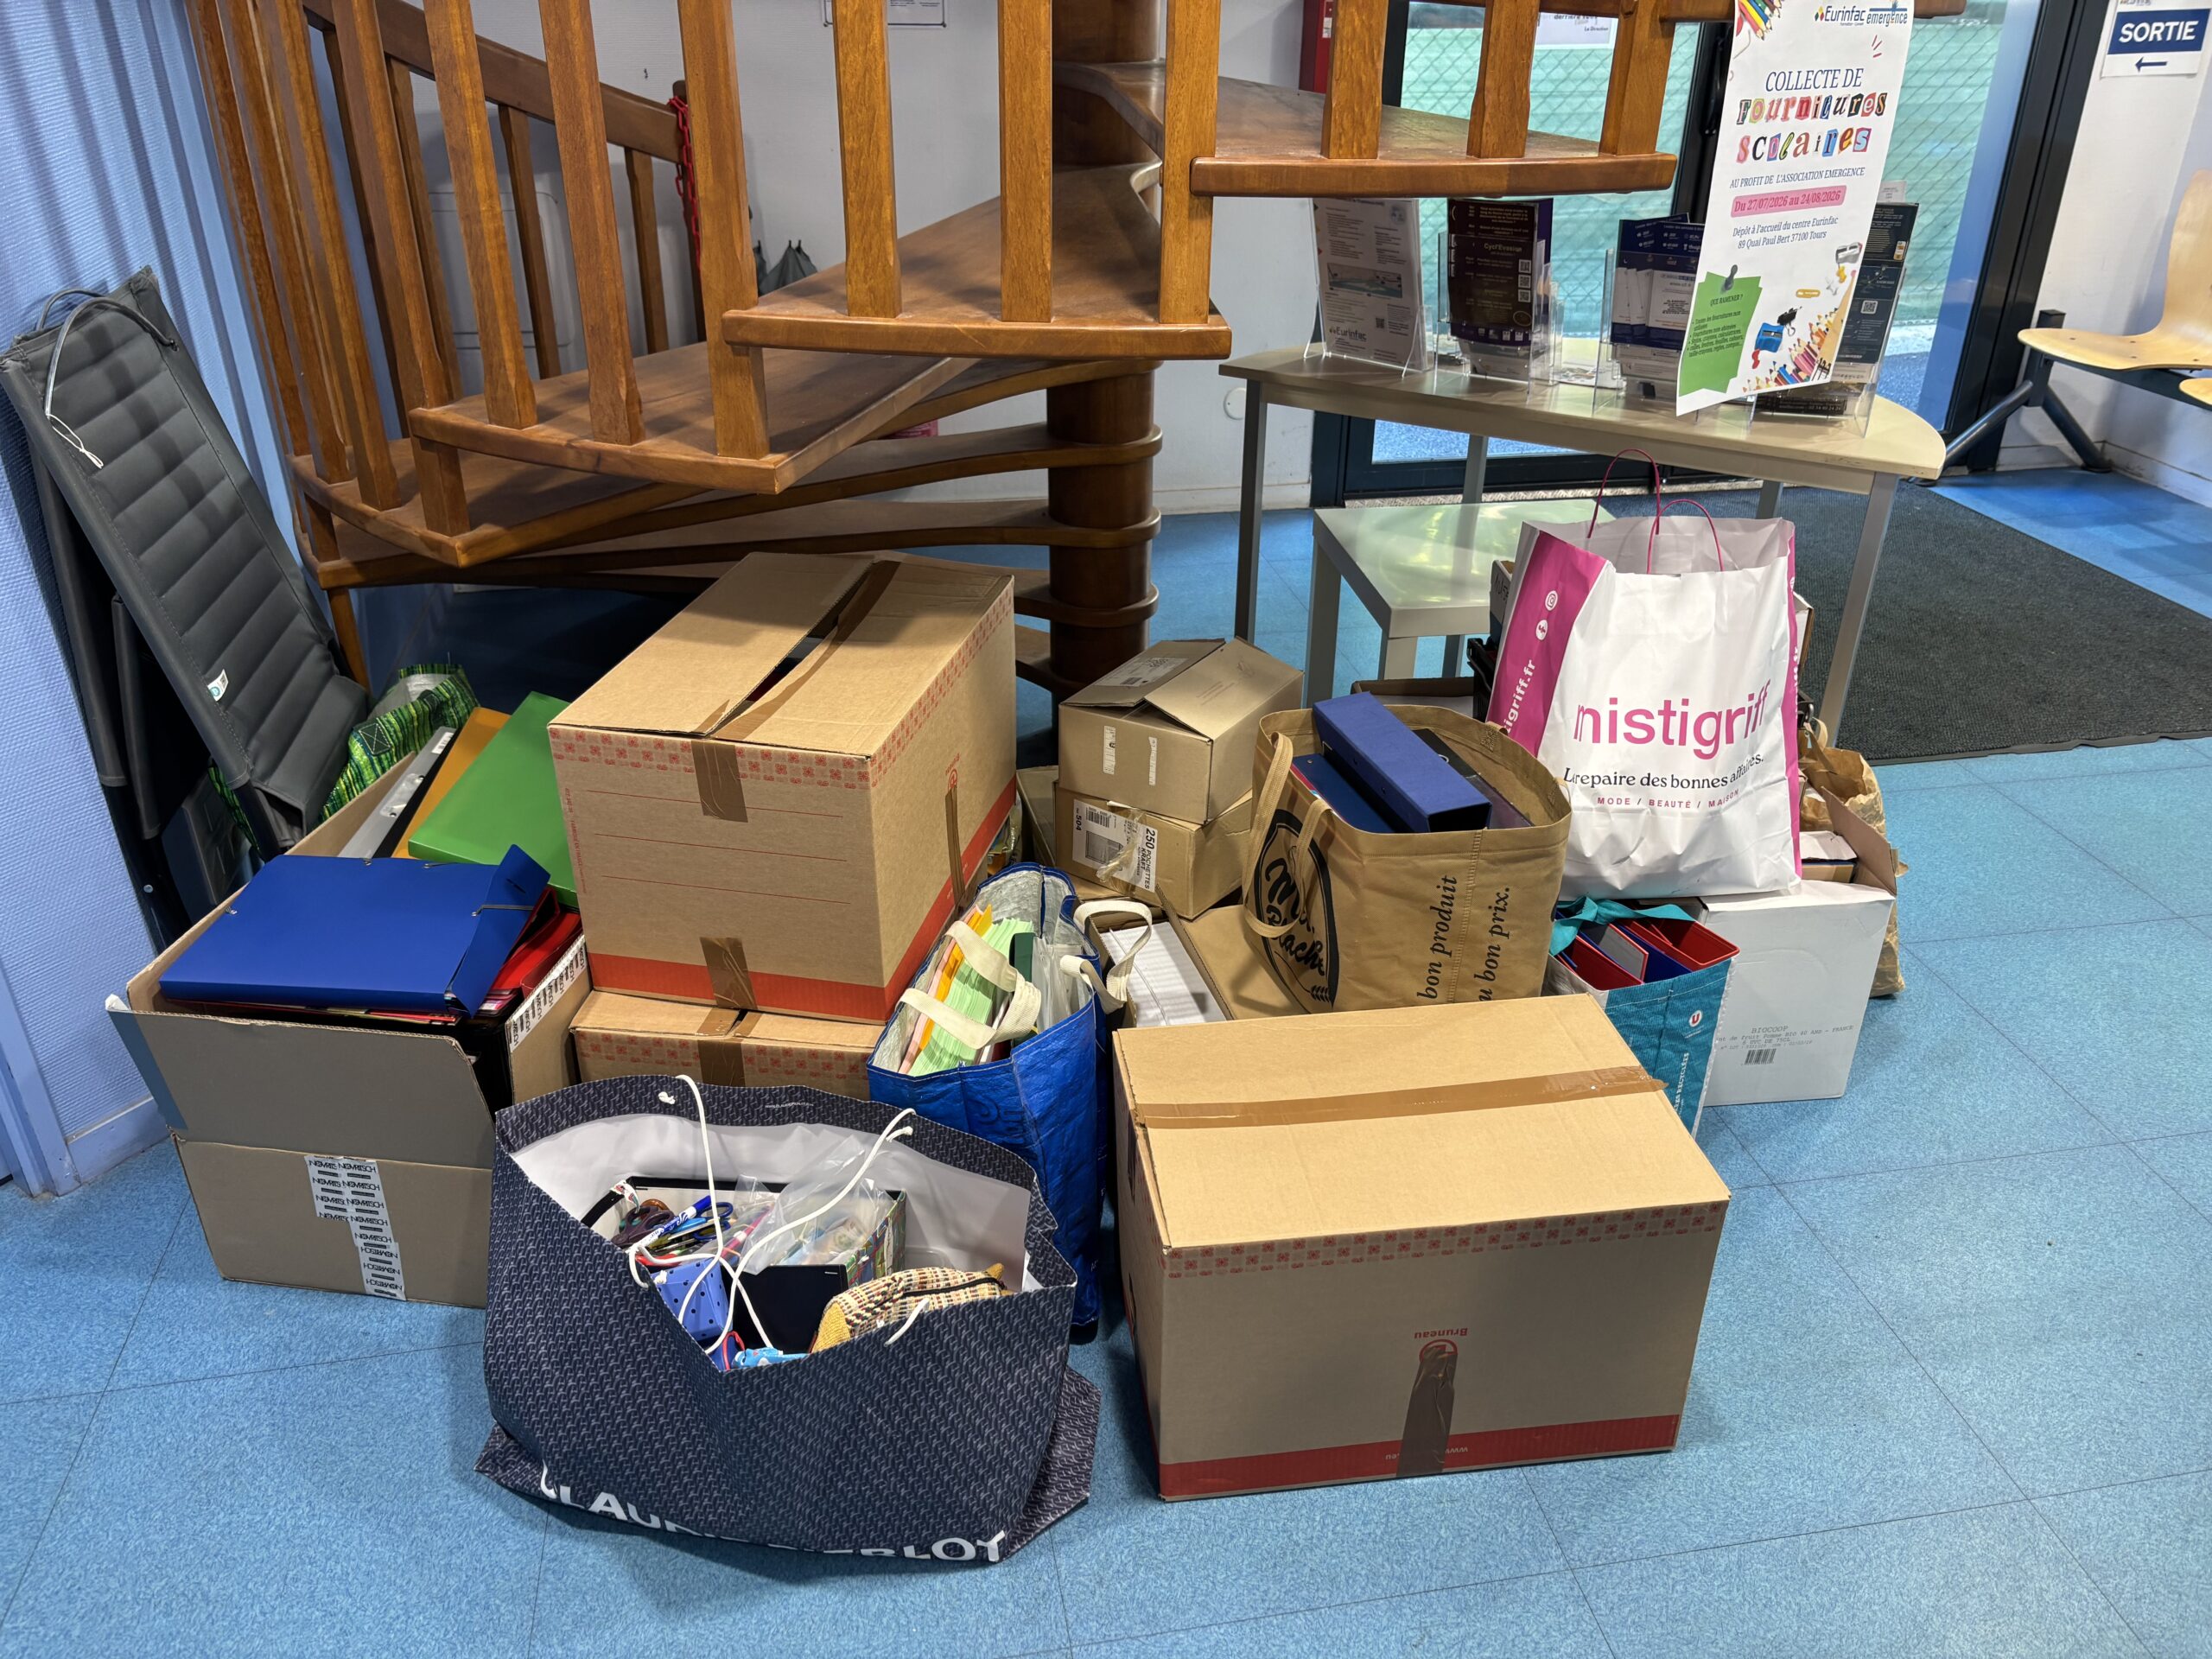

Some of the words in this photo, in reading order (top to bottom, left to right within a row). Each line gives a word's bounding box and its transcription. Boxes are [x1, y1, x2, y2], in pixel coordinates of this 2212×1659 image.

[1824, 5, 1866, 22] Eurinfac
[2119, 21, 2199, 42] SORTIE
[1765, 69, 1840, 92] COLLECTE
[1842, 68, 1864, 88] DE
[1730, 179, 1739, 188] AU
[1740, 176, 1764, 187] PROFIT
[1764, 175, 1774, 185] DE
[1776, 169, 1825, 183] L'ASSOCIATION
[1825, 168, 1866, 178] EMERGENCE
[1734, 200, 1745, 213] Du
[1747, 195, 1787, 211] 27/07/2026
[1789, 196, 1799, 206] au
[1801, 190, 1841, 206] 24/08/2026
[1733, 226, 1751, 238] Dépôt
[1751, 226, 1756, 234] à
[1757, 221, 1782, 234] l'accueil
[1783, 220, 1790, 230] du
[1791, 219, 1810, 229] centre
[1811, 216, 1839, 227] Eurinfac
[1738, 239, 1745, 249] 89
[1746, 237, 1761, 248] Quai
[1762, 235, 1776, 245] Paul
[1777, 233, 1790, 244] Bert
[1790, 232, 1808, 243] 37100
[1809, 230, 1827, 240] Tours
[1336, 327, 1367, 341] Eurinfac
[1503, 659, 1536, 734] tigriff.fr
[1573, 678, 1771, 760] mistigriff
[1576, 772, 1636, 788] repaire
[1641, 772, 1668, 788] des
[1671, 774, 1728, 788] bonnes
[1730, 753, 1764, 784] affaires.
[1597, 797, 1631, 805] MODE
[1649, 798, 1692, 809] BEAUTÉ
[1708, 788, 1738, 808] MAISON
[1146, 828, 1156, 849] 250
[1429, 874, 1458, 957] produit
[1474, 944, 1502, 982] bon
[1489, 887, 1510, 940] prix.
[1417, 961, 1442, 999] bon
[1751, 1025, 1789, 1035] BIOCOOP
[1832, 1025, 1854, 1033] FRANCE
[1678, 1052, 1690, 1093] RECYCLÉES
[1414, 1327, 1468, 1339] Bruneau
